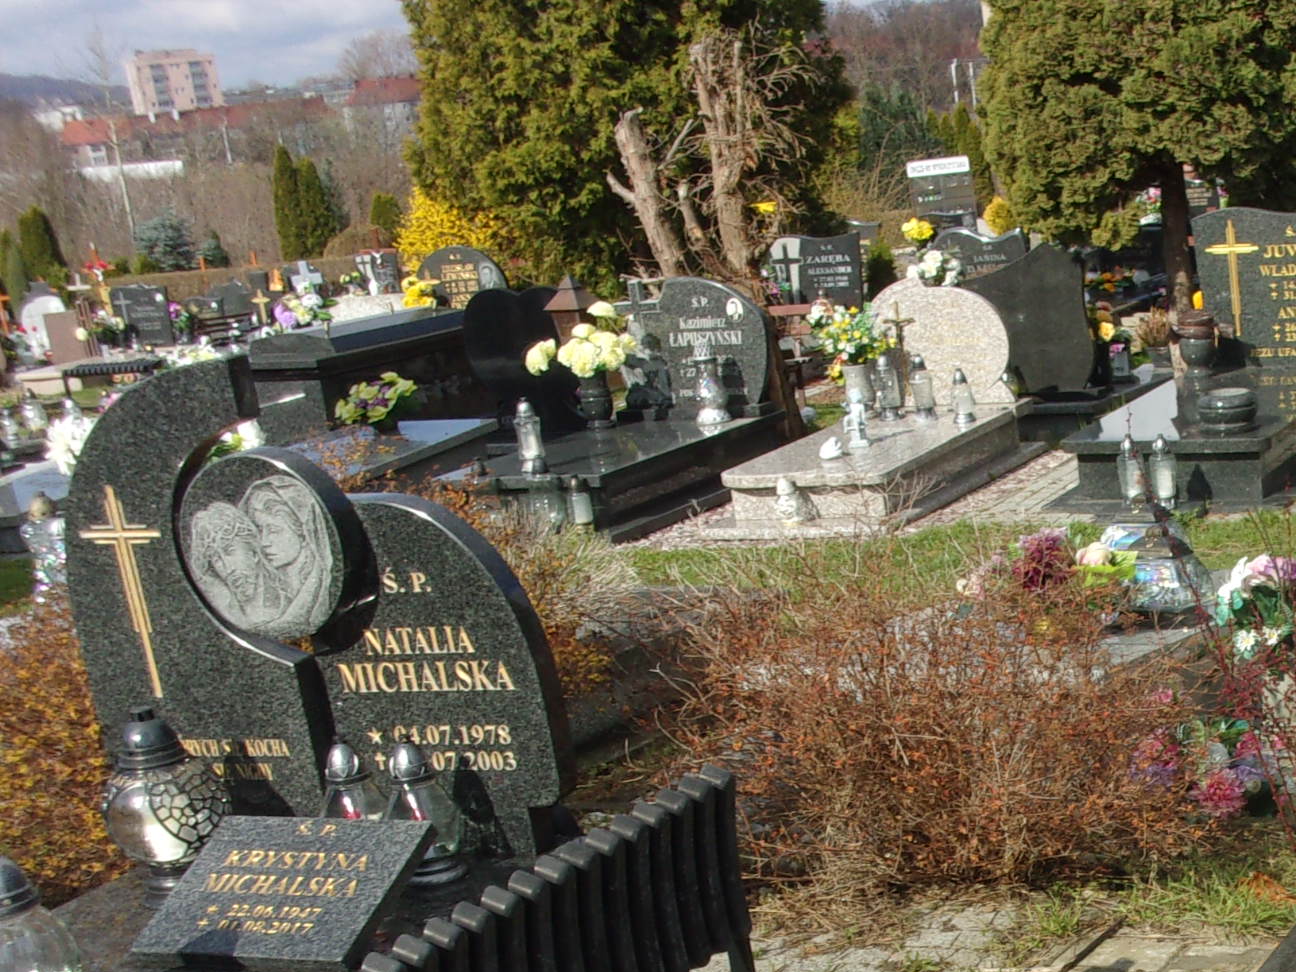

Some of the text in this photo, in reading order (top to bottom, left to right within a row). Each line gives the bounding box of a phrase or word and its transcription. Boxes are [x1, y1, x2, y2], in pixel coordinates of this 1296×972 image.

[679, 315, 727, 329] Kazimierz
[362, 624, 476, 656] NATALIA
[336, 659, 517, 694] MICHALSKA
[243, 738, 290, 757] KOCHA
[223, 849, 369, 872] KRYSTYNA
[199, 872, 360, 897] MICHALSKA
[226, 904, 322, 920] 22.06.1947
